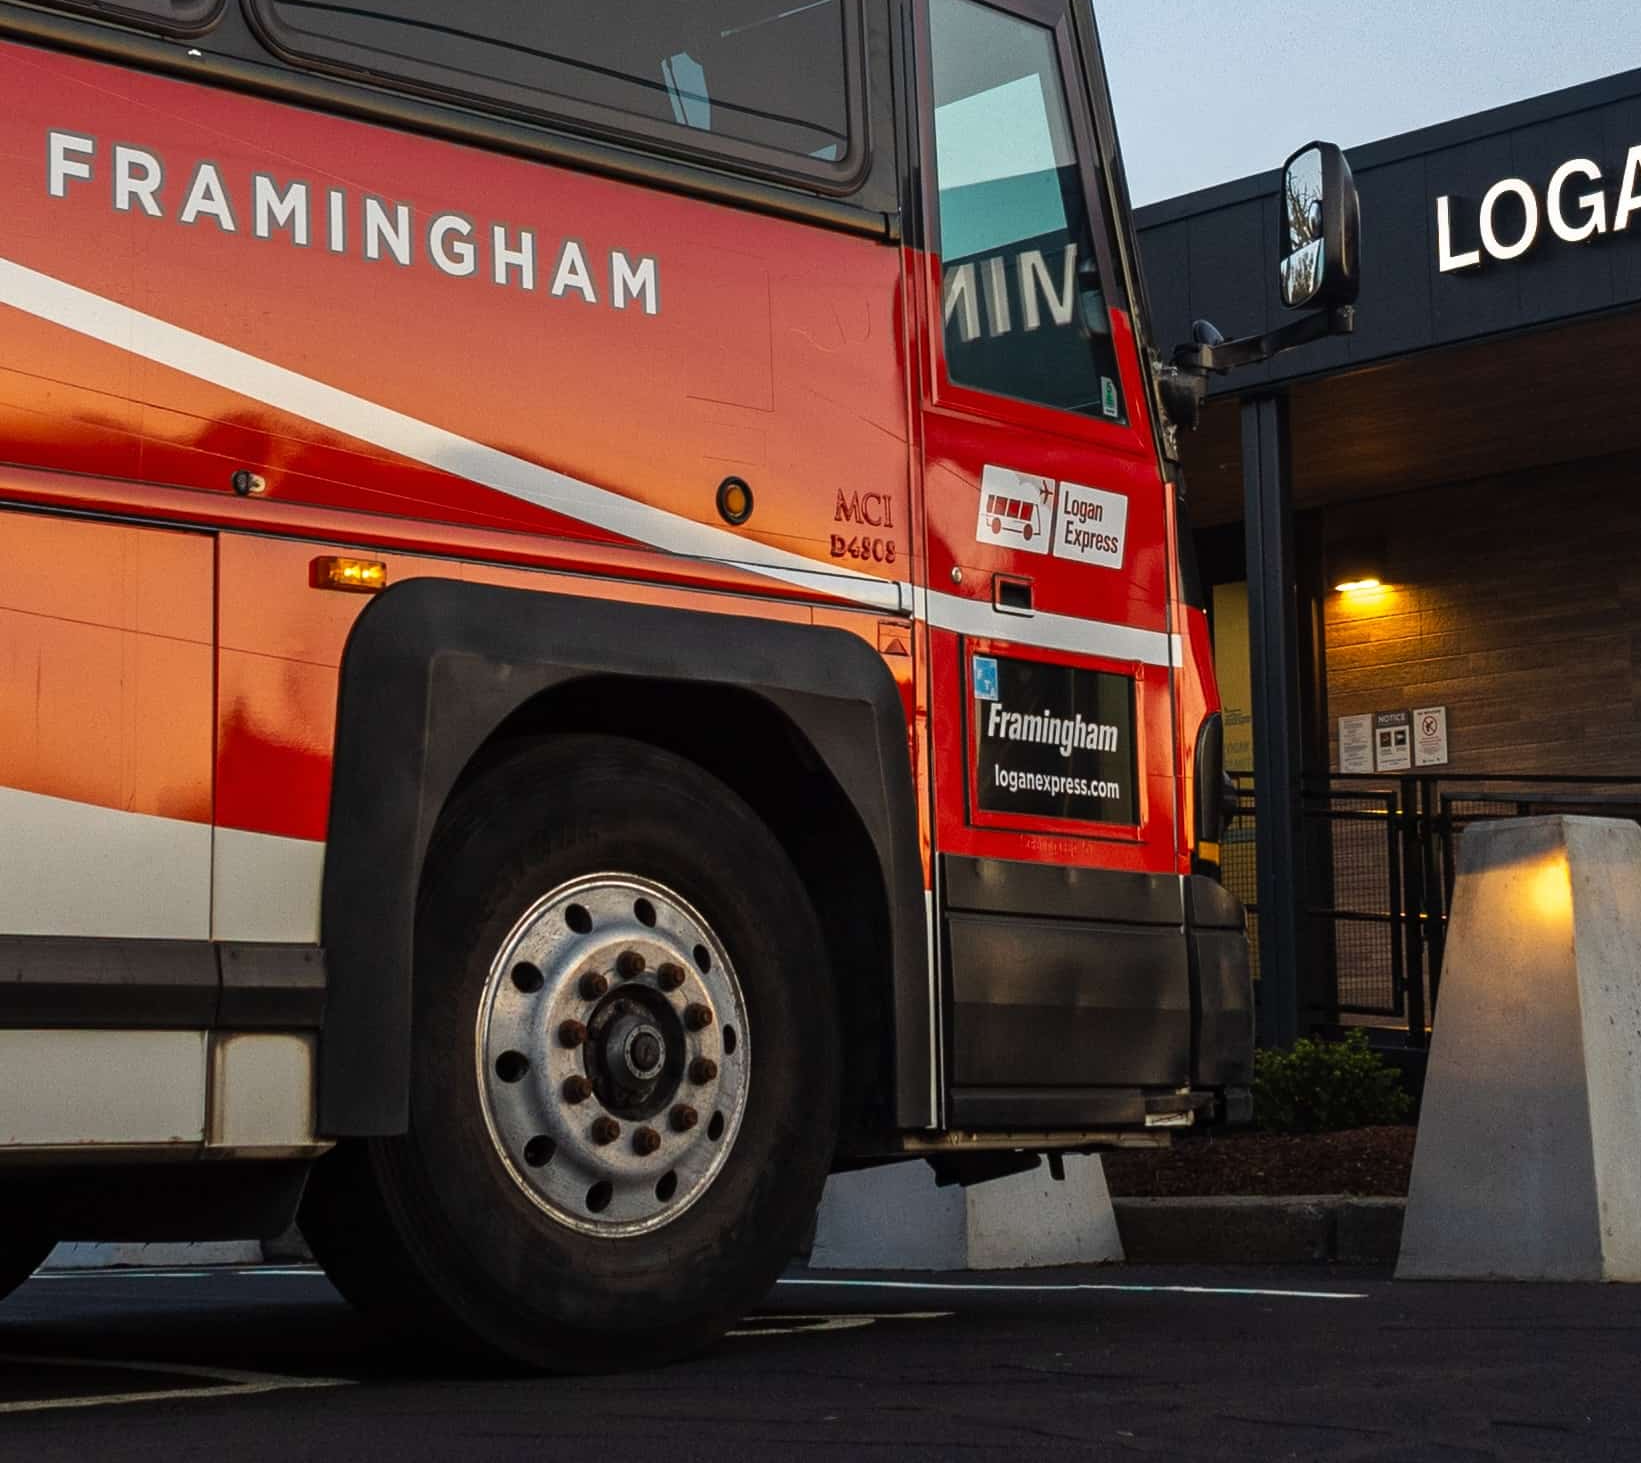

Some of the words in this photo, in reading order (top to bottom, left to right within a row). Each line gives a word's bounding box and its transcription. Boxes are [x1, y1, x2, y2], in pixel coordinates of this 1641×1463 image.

[46, 131, 661, 315] FRAMINGHAM
[834, 487, 895, 529] MCI
[1063, 489, 1104, 524] Logan
[1065, 519, 1119, 554] Express
[987, 702, 1119, 757] Framingham
[994, 763, 1121, 800] loganexpress.com
